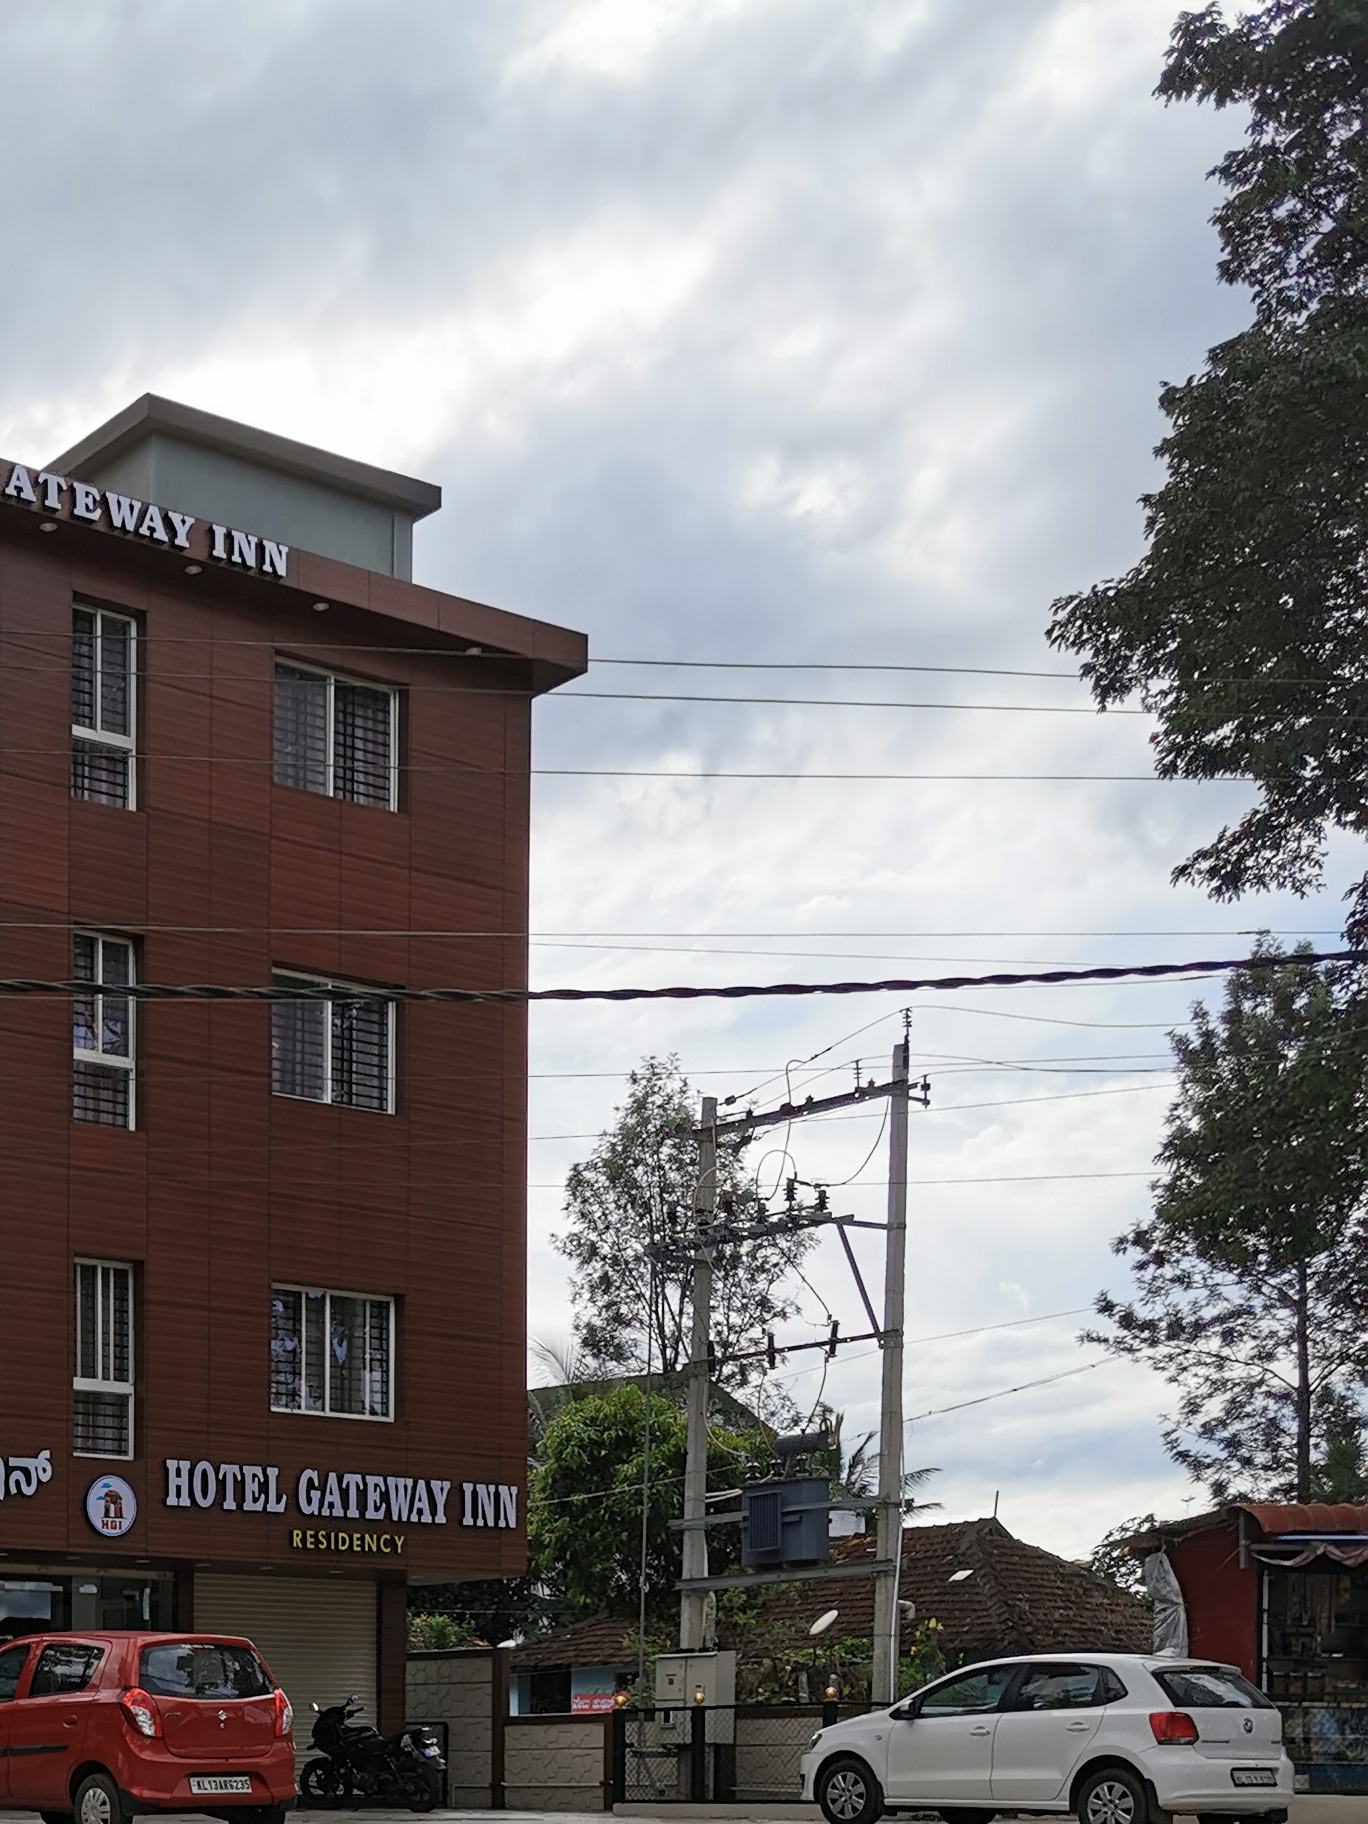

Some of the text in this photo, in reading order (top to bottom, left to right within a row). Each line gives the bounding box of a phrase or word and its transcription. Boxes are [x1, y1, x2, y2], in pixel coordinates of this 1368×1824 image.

[212, 522, 289, 578] INN
[165, 1458, 519, 1529] HOTEL GATEWAY INN
[101, 1519, 123, 1531] HGI
[292, 1529, 406, 1555] RESIDENCY
